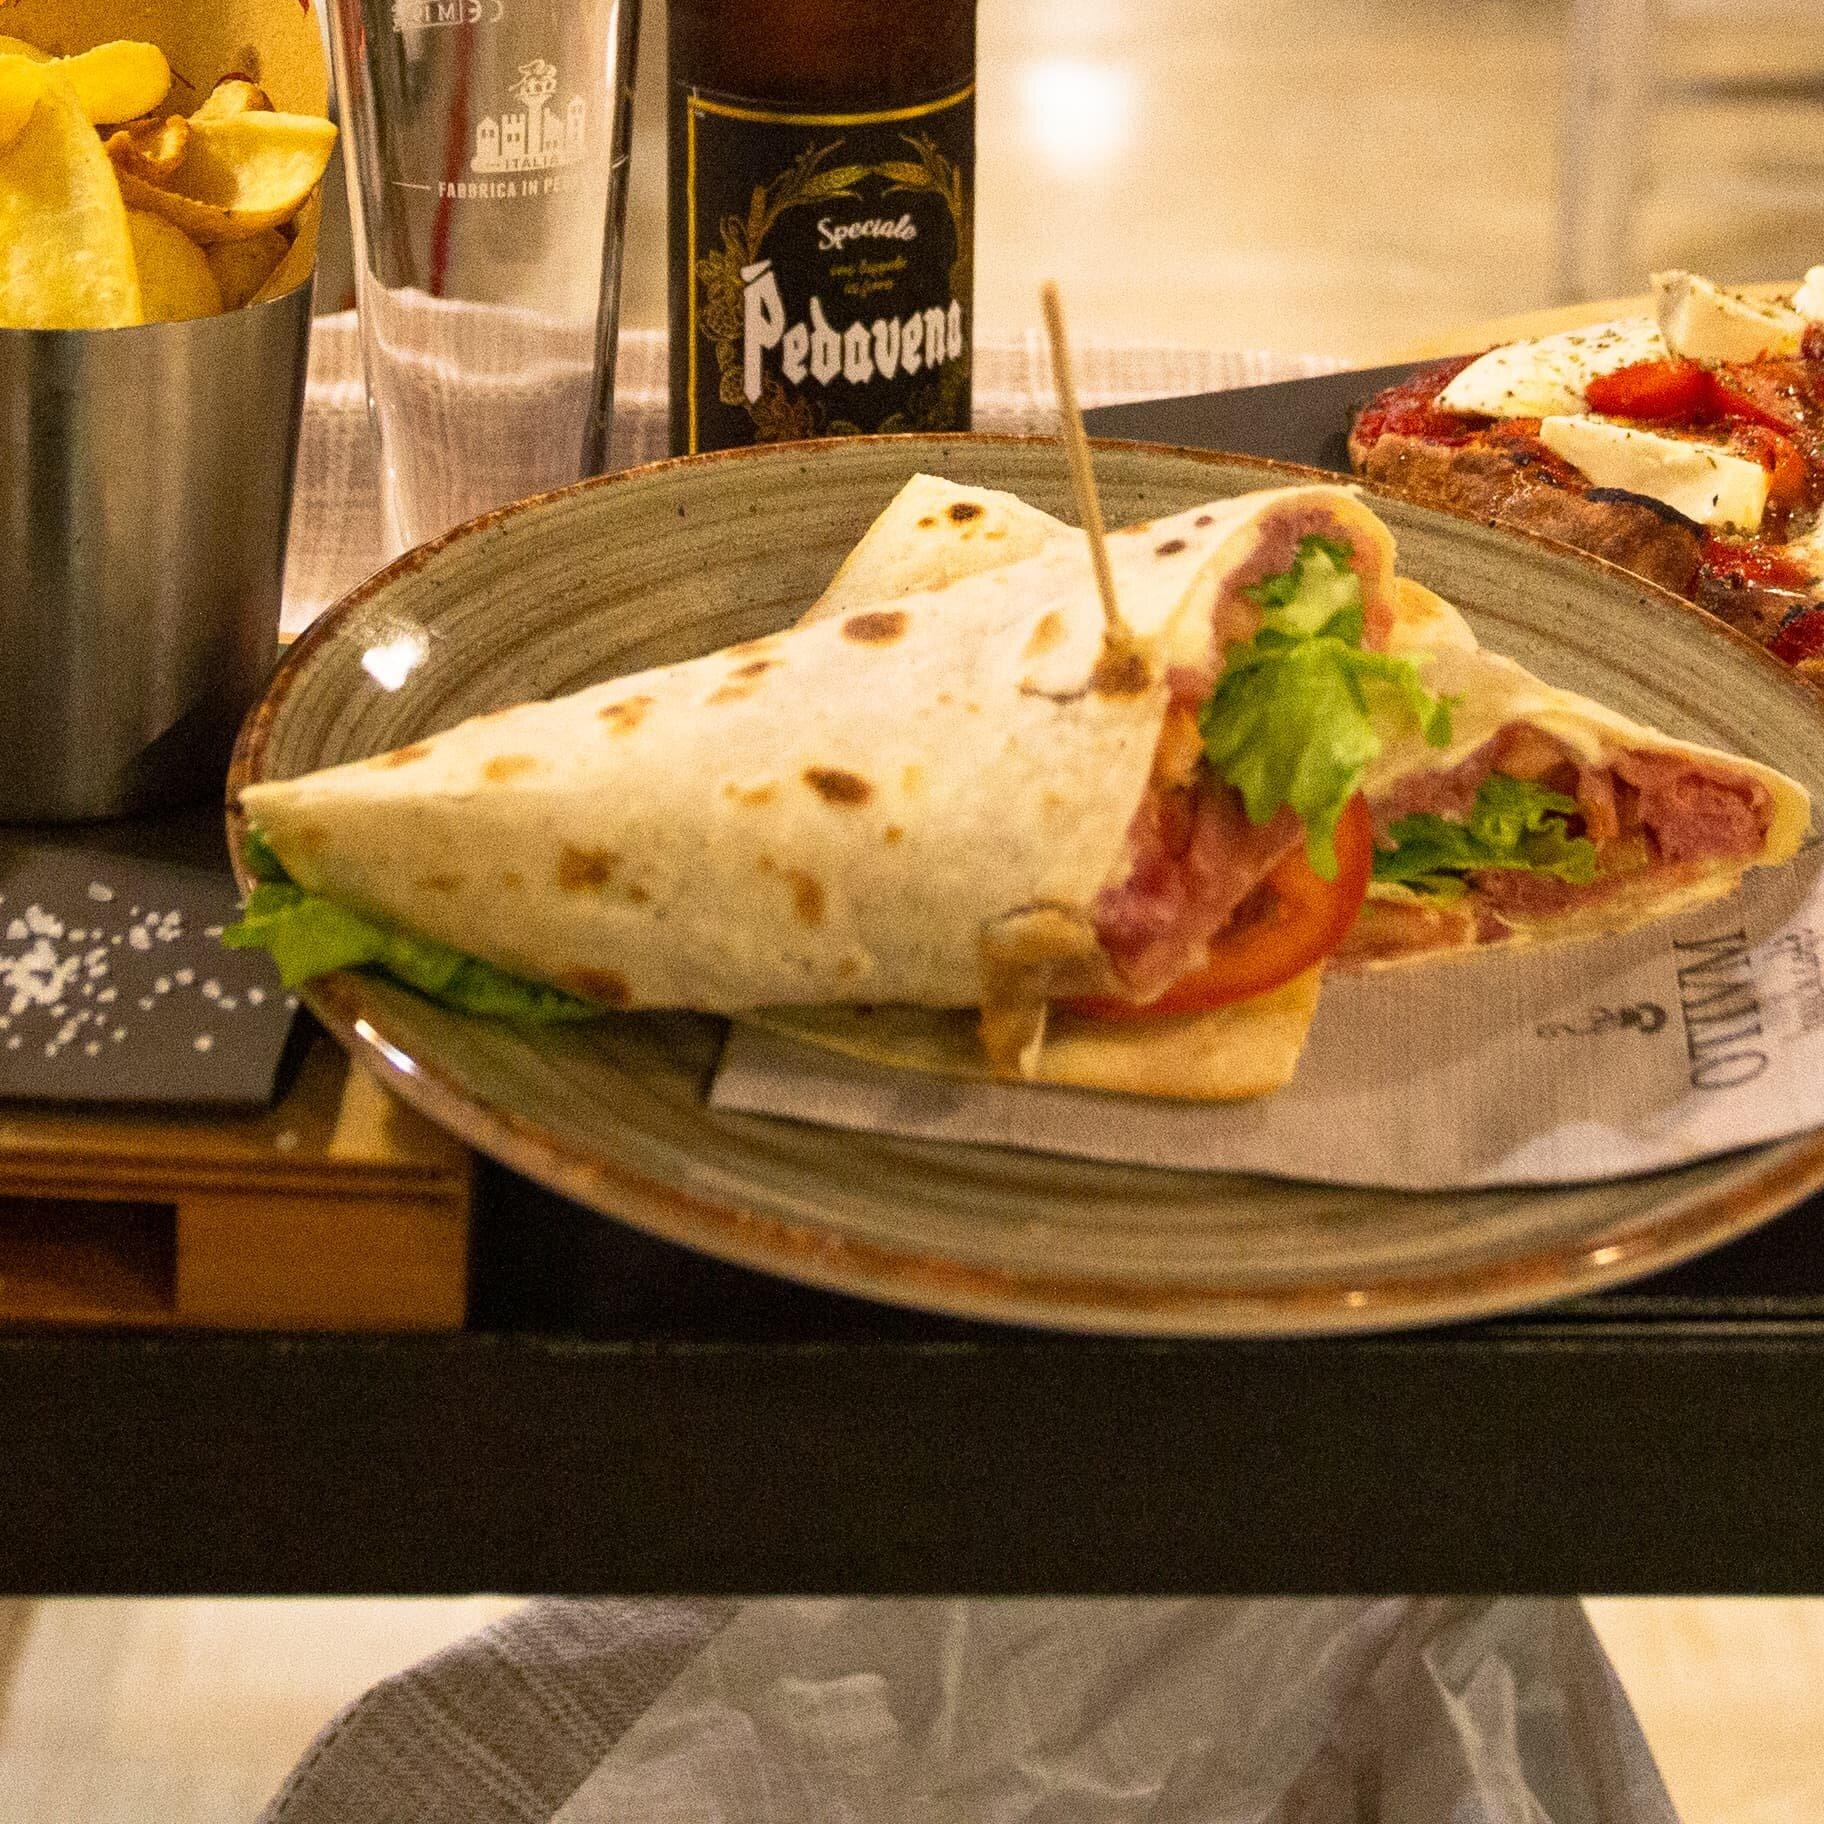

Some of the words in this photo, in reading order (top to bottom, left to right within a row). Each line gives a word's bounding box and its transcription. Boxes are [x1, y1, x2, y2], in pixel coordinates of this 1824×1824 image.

[505, 156, 559, 170] ITALIA
[438, 181, 517, 199] FABBRICA
[522, 180, 538, 197] IN
[817, 214, 917, 250] Speciale
